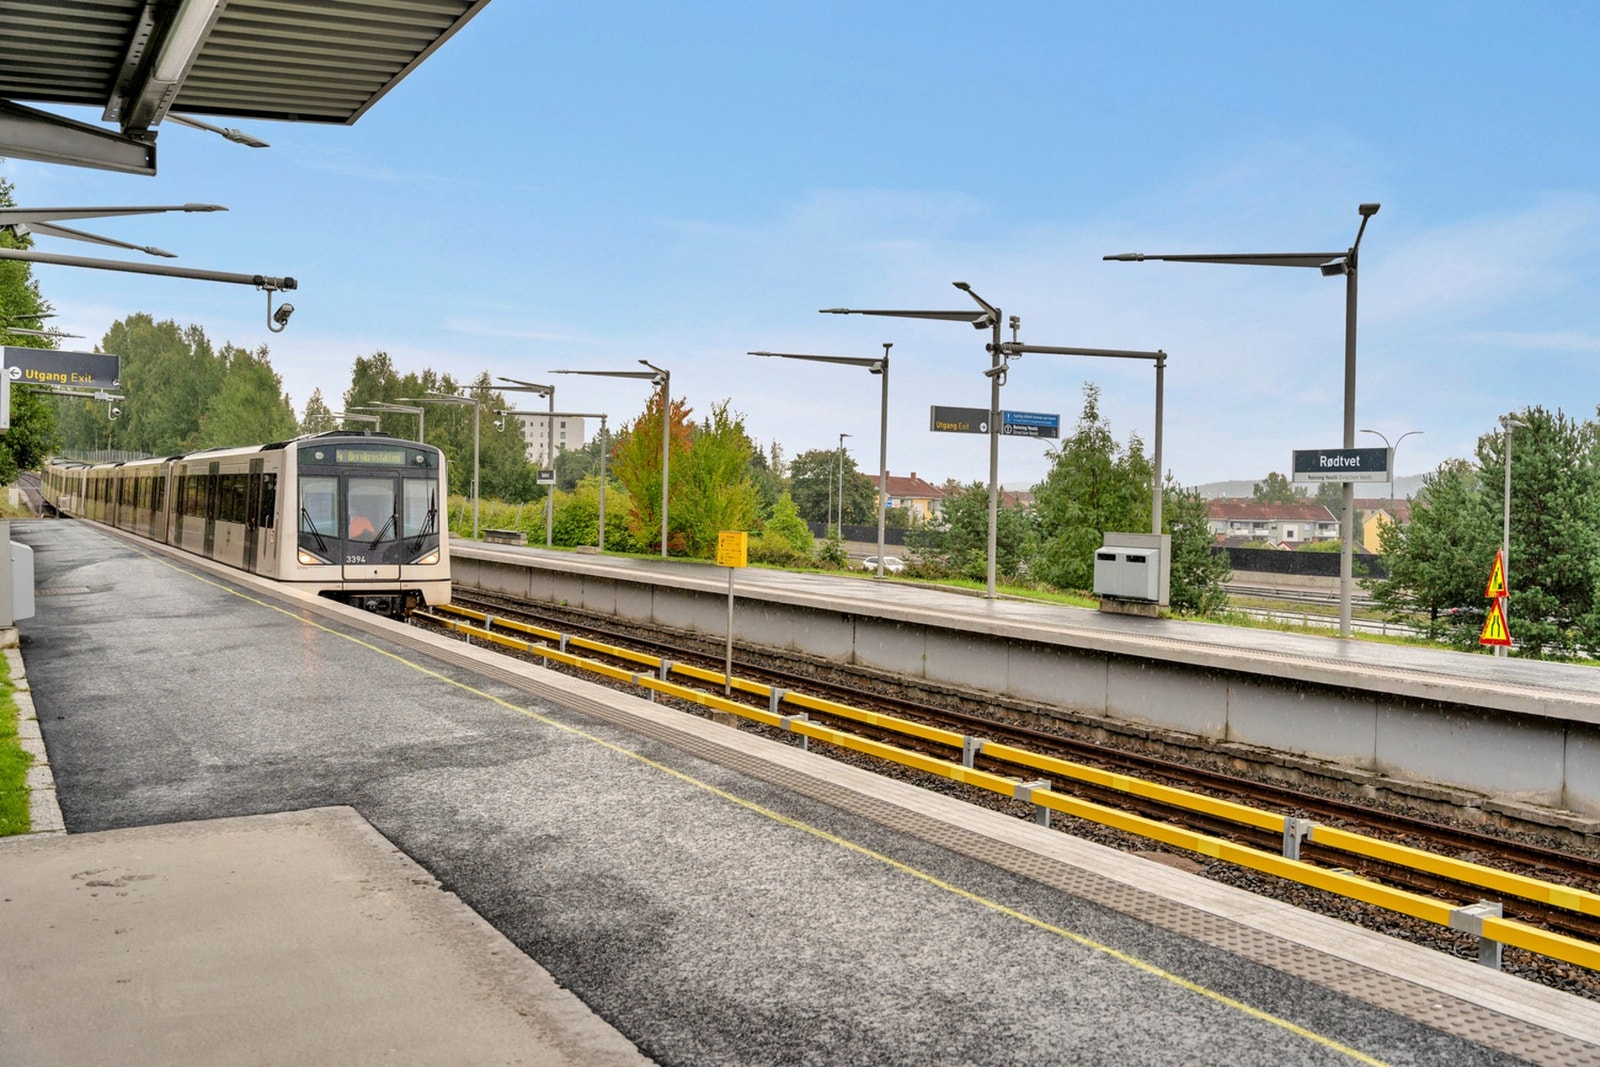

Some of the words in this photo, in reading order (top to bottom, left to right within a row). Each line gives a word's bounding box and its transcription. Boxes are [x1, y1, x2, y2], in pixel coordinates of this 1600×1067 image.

[25, 369, 67, 384] Utgang
[71, 373, 92, 383] Exit
[936, 421, 957, 431] Utgang
[958, 422, 970, 430] Exit
[1319, 455, 1361, 467] Rødtvet
[346, 555, 366, 563] 3394
